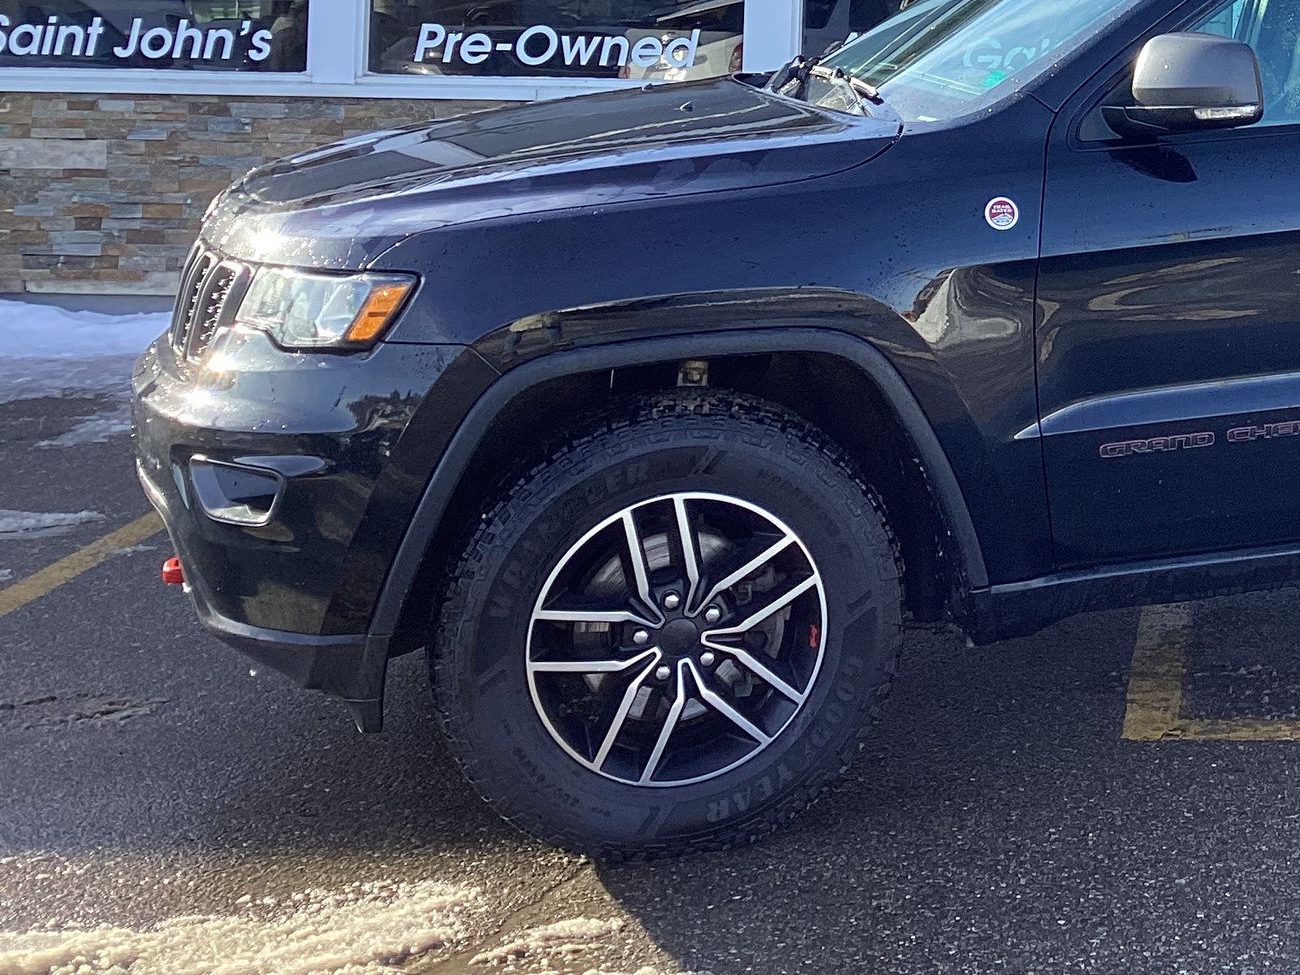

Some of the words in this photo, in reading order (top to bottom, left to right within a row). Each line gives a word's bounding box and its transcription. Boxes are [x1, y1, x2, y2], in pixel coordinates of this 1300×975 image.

[113, 18, 272, 62] John's
[413, 23, 700, 68] Pre-Owned
[1100, 432, 1214, 457] GRAND
